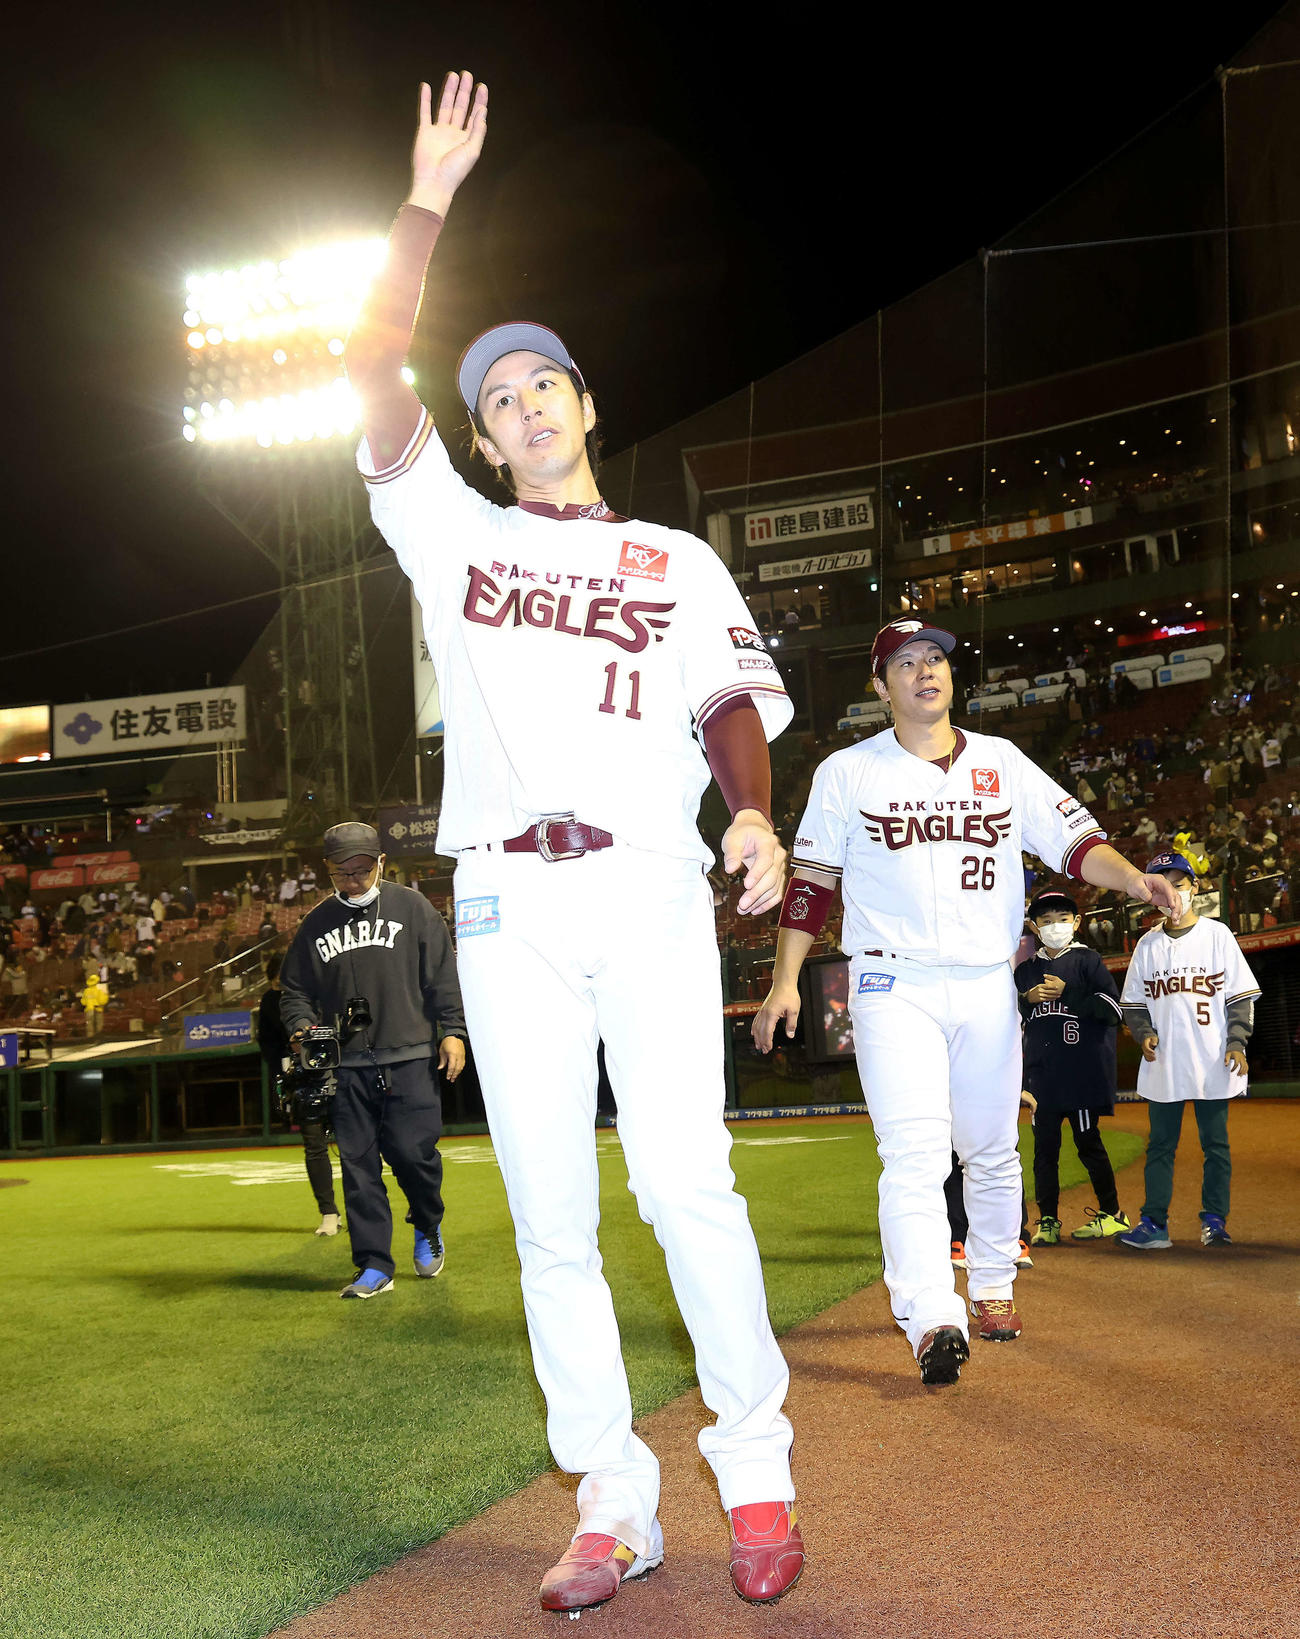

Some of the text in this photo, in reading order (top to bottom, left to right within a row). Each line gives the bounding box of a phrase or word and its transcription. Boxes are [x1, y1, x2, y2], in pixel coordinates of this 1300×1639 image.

[775, 503, 870, 537] 鹿島建設
[490, 560, 626, 592] RAKUTEN
[463, 564, 677, 653] EAGLES
[599, 661, 641, 720] 11
[110, 699, 237, 741] 住友電設
[889, 800, 982, 812] RAKUTEN
[409, 819, 438, 837] 松栄
[859, 807, 1012, 850] EAGLES
[961, 856, 995, 890] 26
[315, 918, 404, 963] GNARLY
[1196, 1002, 1210, 1025] 5
[1063, 1020, 1080, 1044] 6
